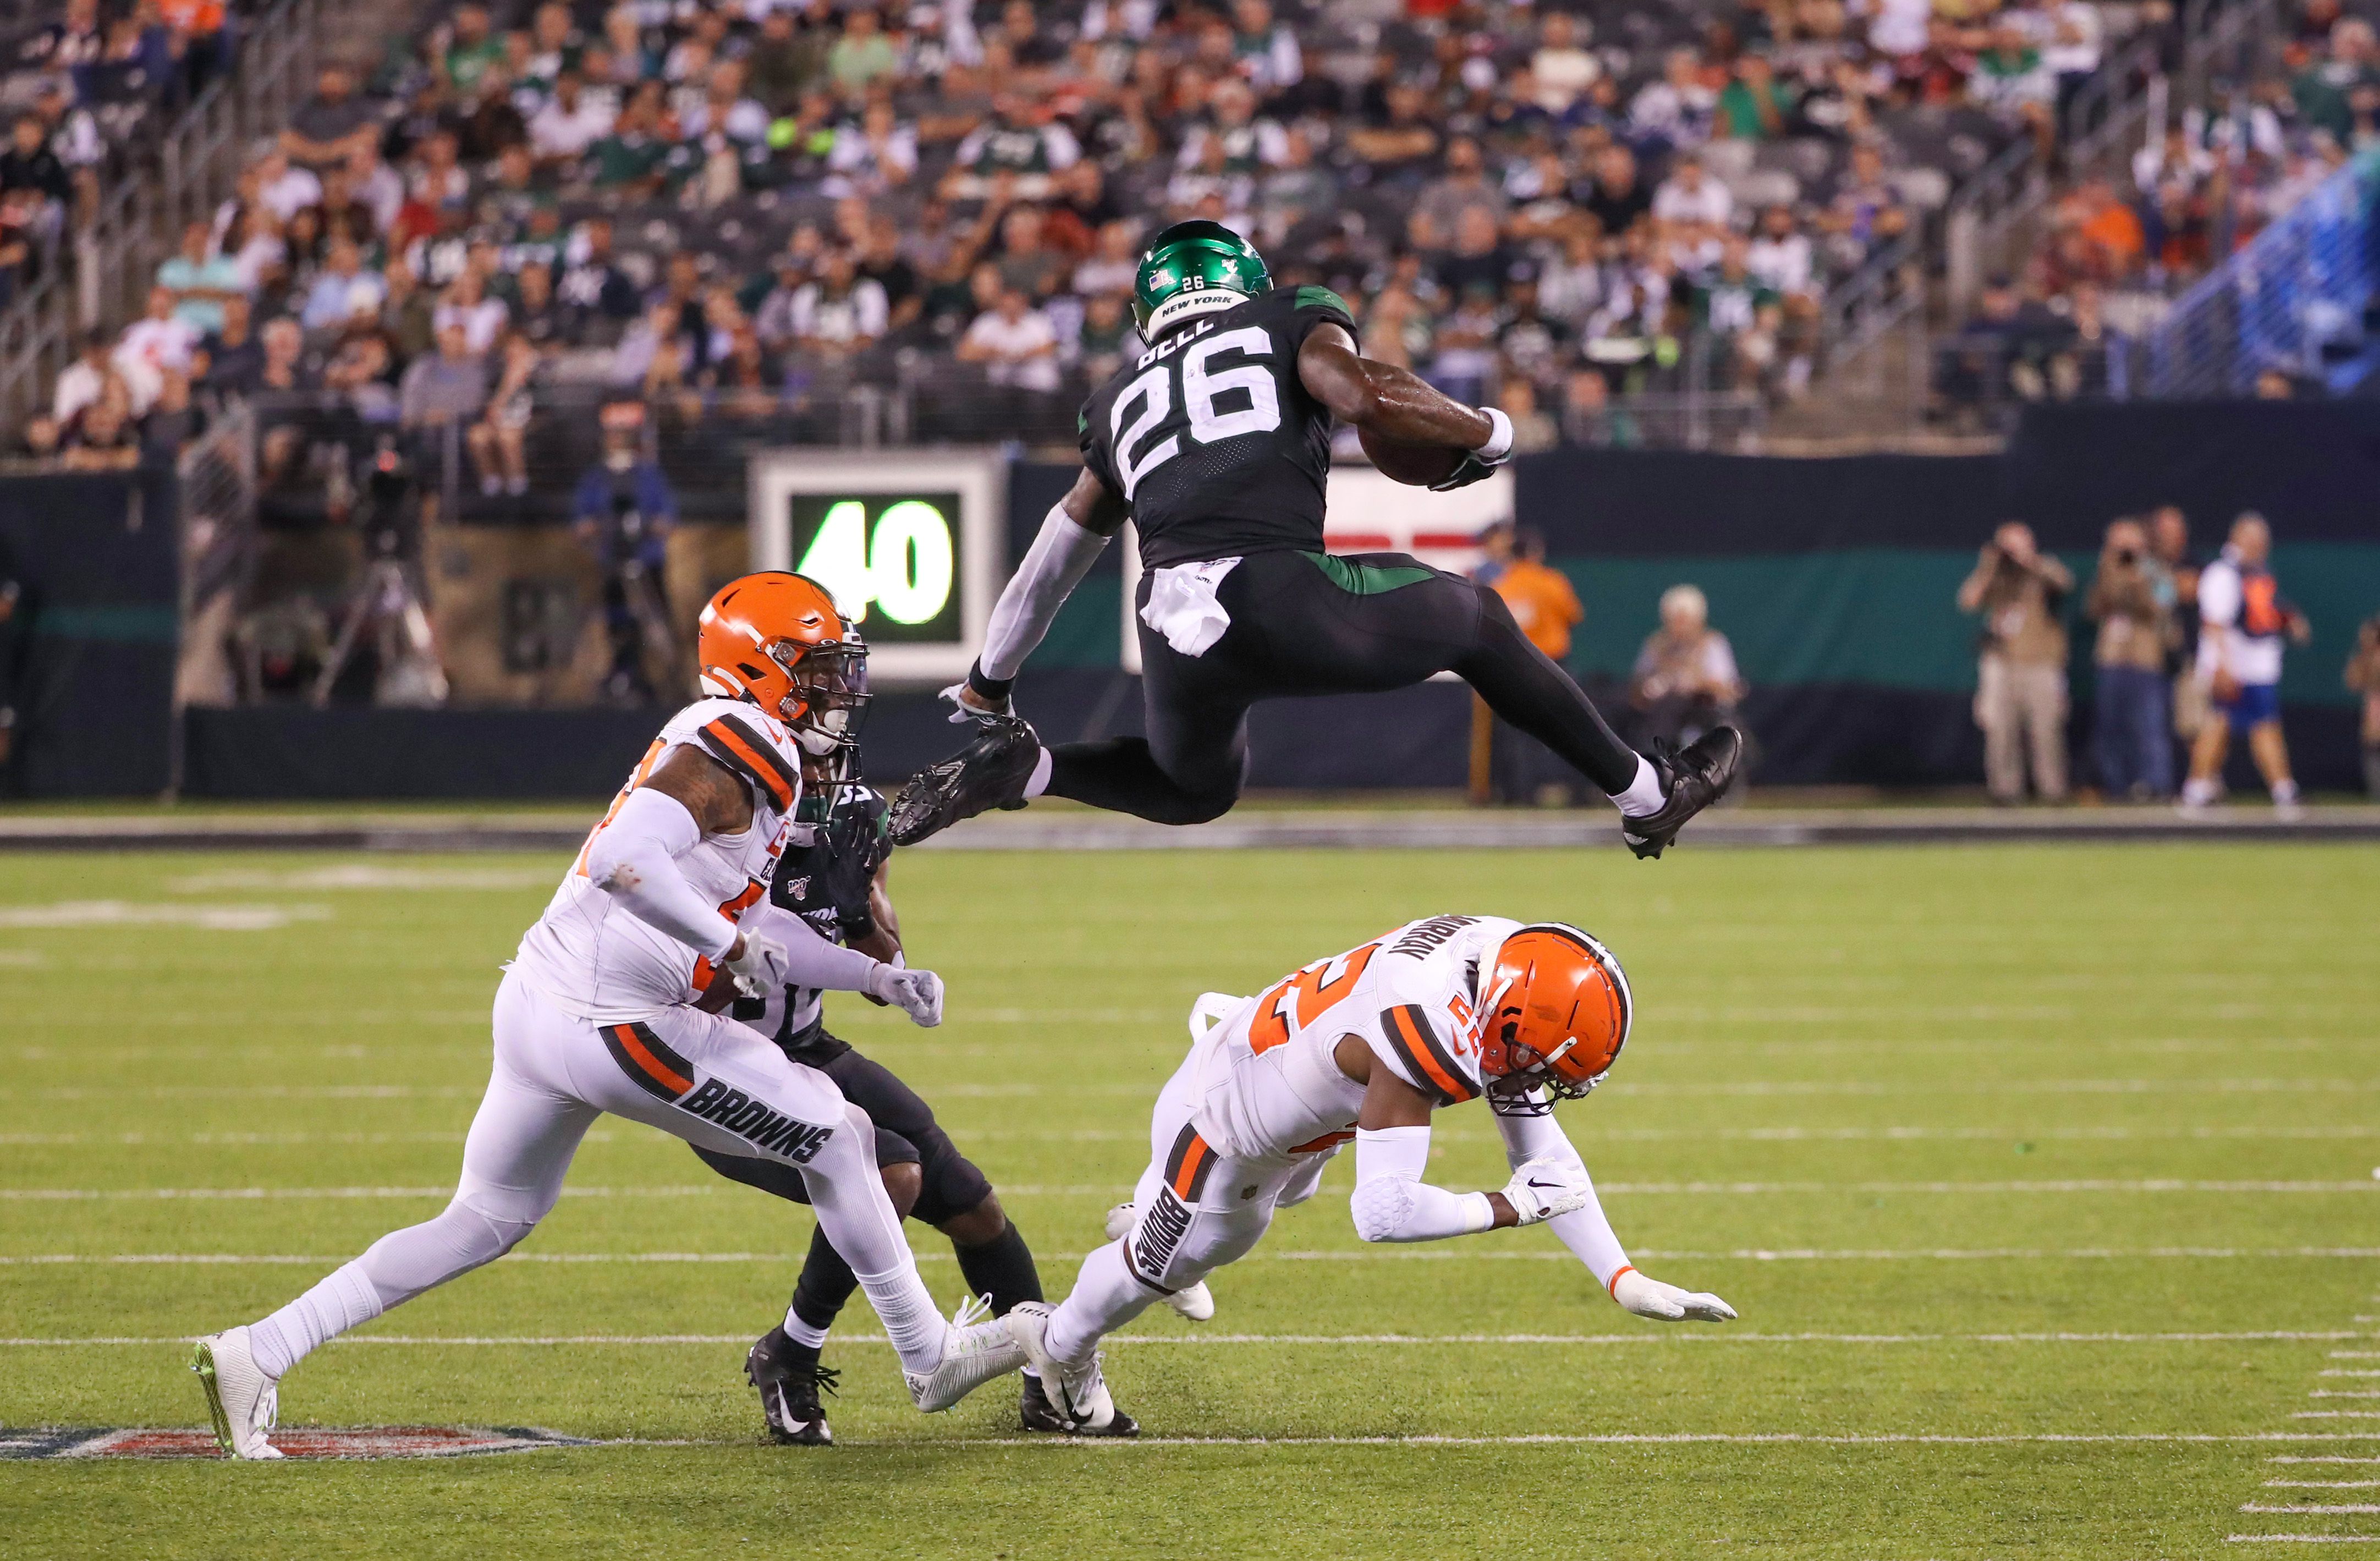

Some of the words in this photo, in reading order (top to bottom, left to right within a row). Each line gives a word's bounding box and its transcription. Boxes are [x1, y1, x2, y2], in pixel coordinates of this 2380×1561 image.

[1162, 300, 1190, 317] NEW
[1194, 296, 1233, 305] YORK
[1182, 276, 1205, 292] 26
[1111, 326, 1281, 502] 26
[796, 501, 953, 624] 40
[1388, 916, 1482, 961] MURRAY
[679, 1078, 834, 1163] BROWNS
[1135, 1185, 1192, 1277] BROWNS
